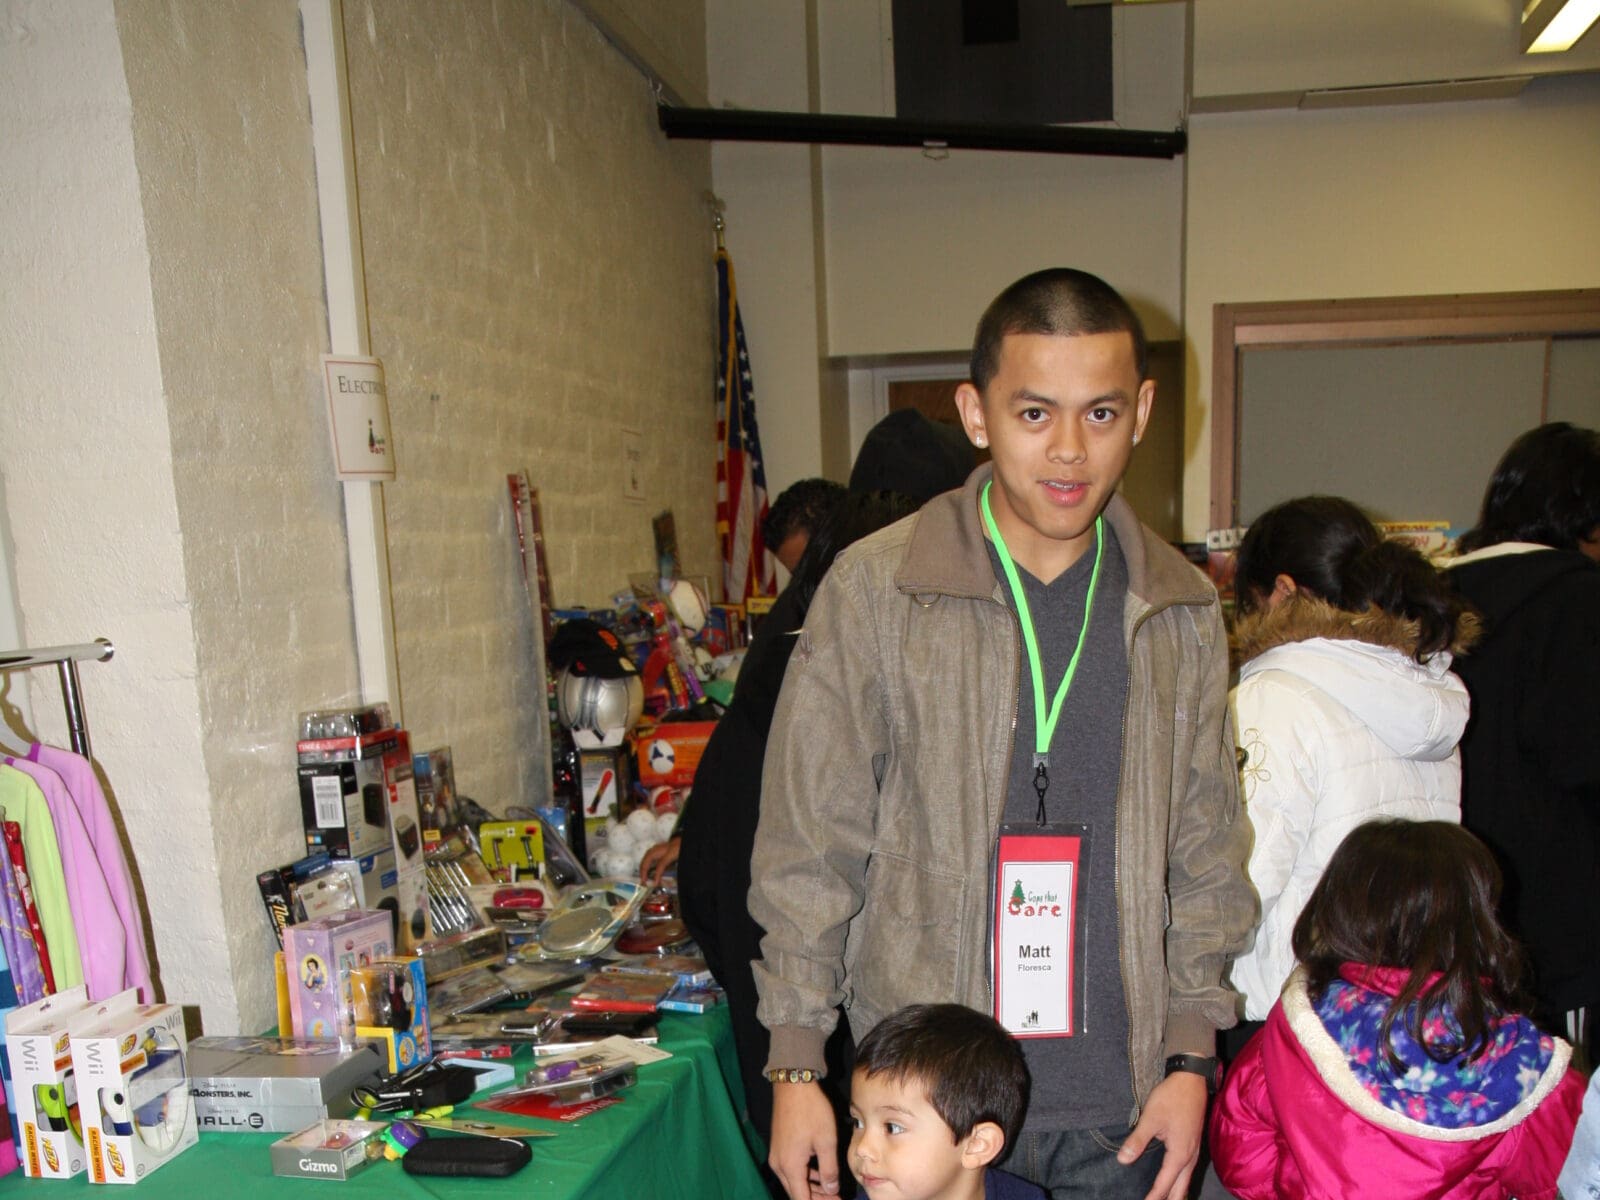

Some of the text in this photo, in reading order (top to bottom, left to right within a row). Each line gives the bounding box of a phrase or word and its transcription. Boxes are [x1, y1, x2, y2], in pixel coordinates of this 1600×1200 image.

[1008, 897, 1062, 917] Care
[1019, 944, 1051, 958] Matt
[1018, 963, 1052, 972] Floresca
[164, 1013, 183, 1031] Wii
[21, 1039, 39, 1072] Wii
[86, 1042, 104, 1075] Wii
[237, 1090, 253, 1098] INC.
[299, 1158, 338, 1173] Gizmo
